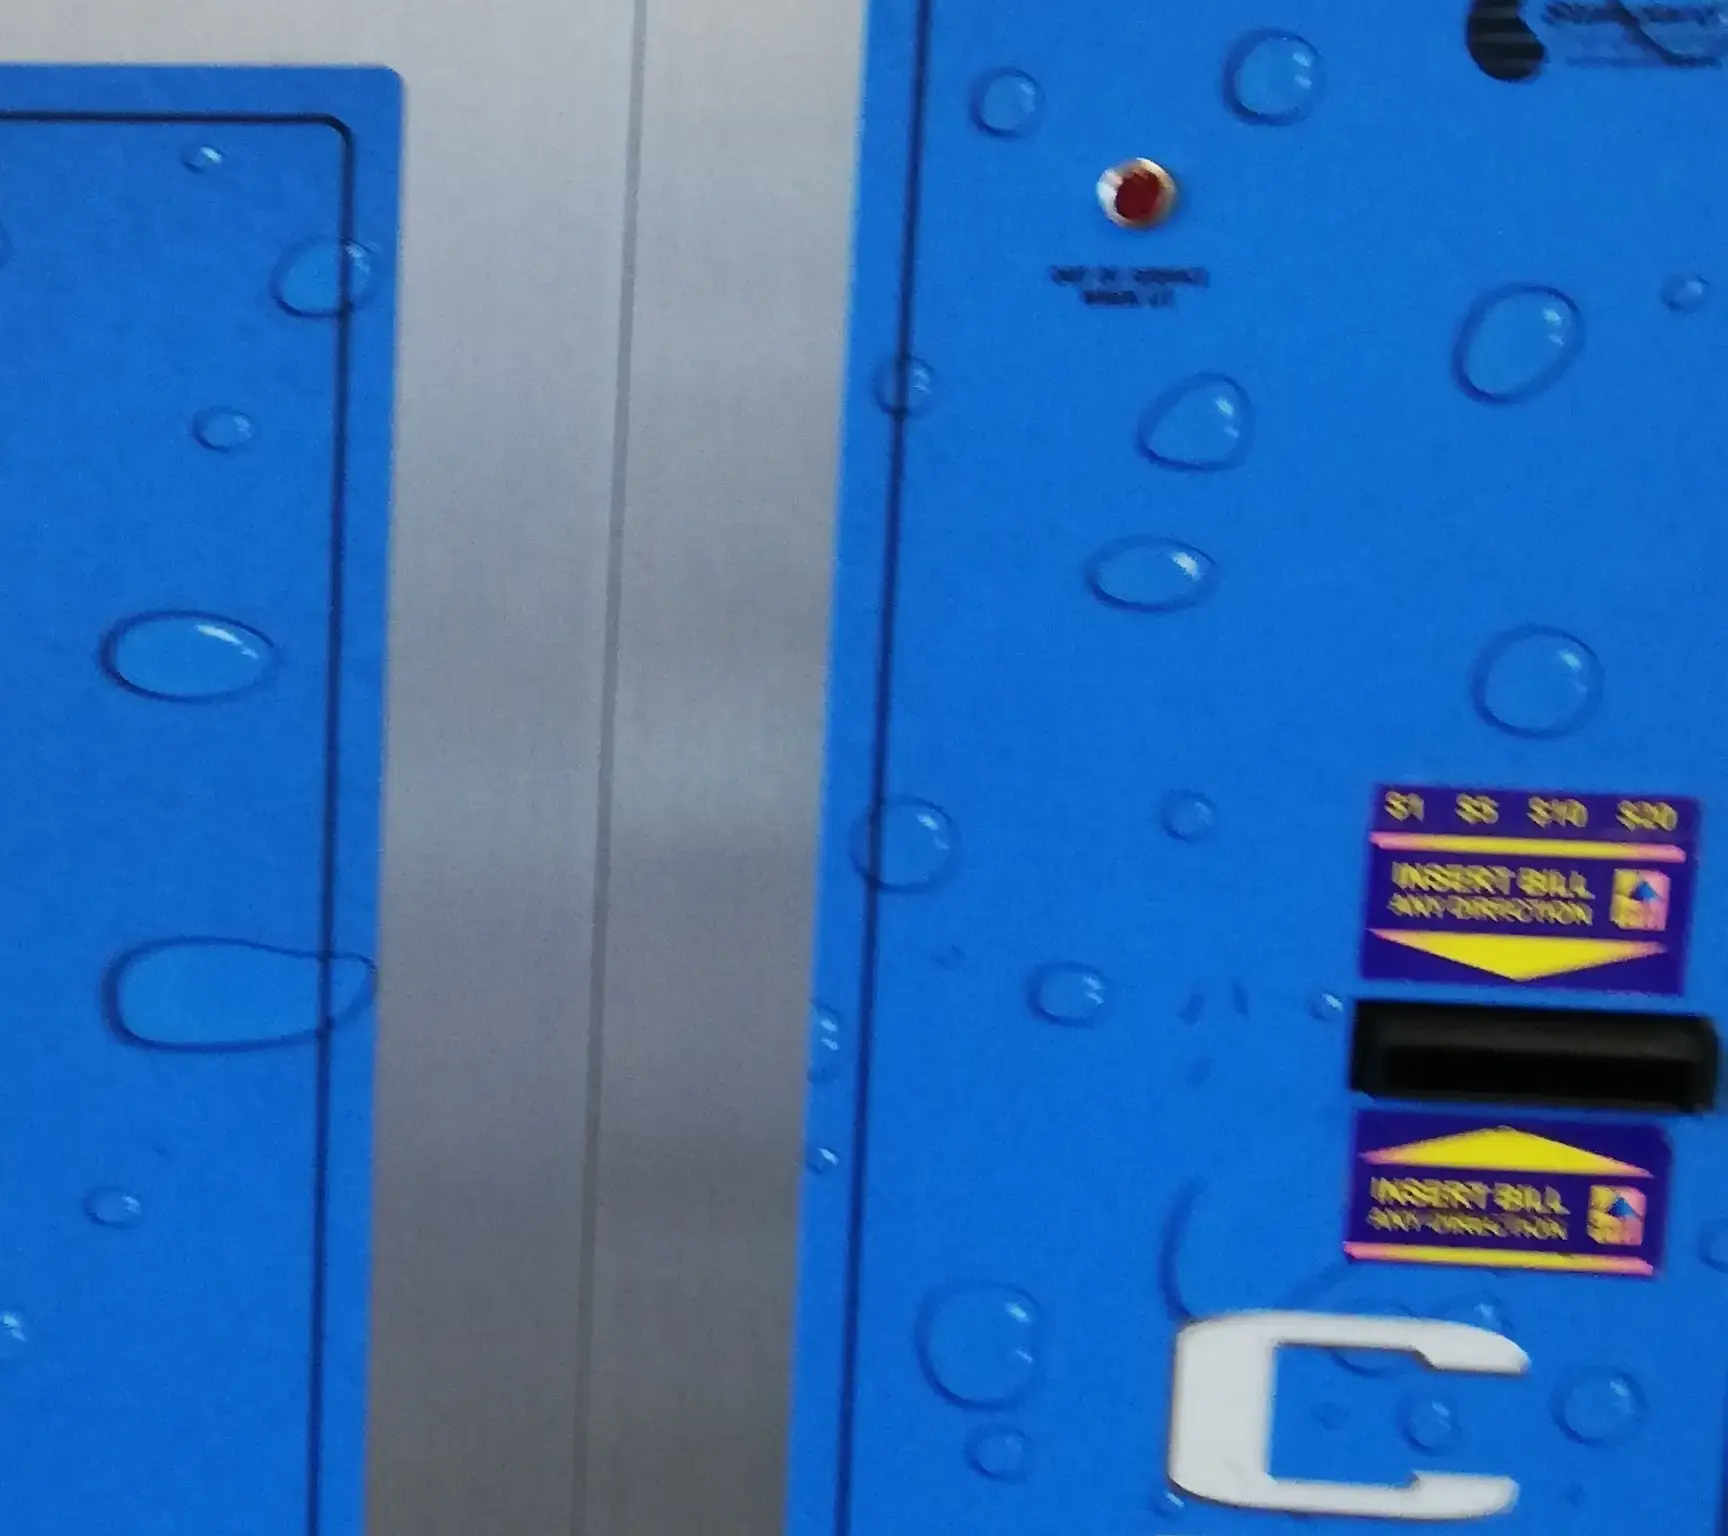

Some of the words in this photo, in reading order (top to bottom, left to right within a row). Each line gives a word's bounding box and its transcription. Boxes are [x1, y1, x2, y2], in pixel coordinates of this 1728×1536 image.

[1391, 862, 1514, 894] INSERT
[1517, 867, 1595, 900] BILL
[1370, 1176, 1490, 1210] INSERT
[1492, 1181, 1571, 1215] BILL
